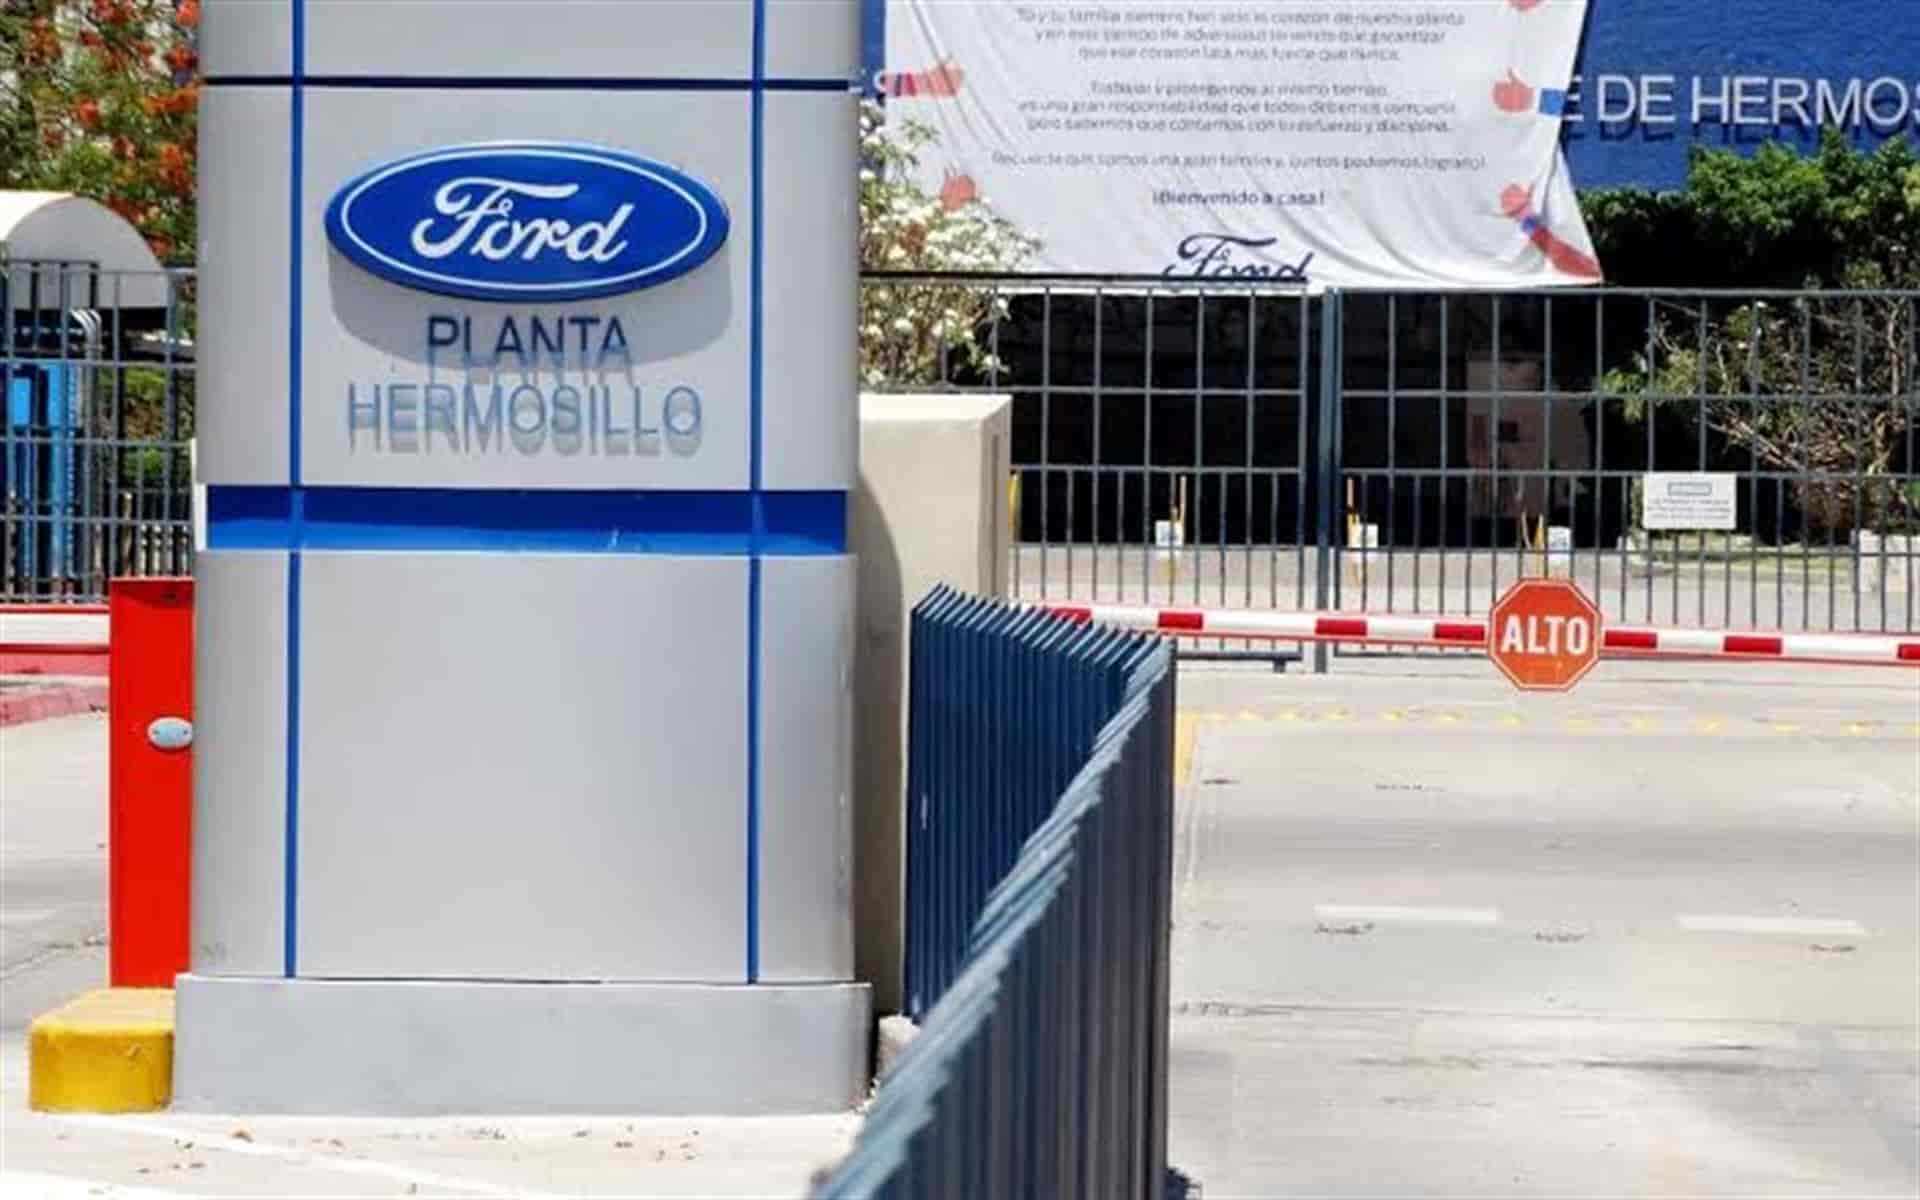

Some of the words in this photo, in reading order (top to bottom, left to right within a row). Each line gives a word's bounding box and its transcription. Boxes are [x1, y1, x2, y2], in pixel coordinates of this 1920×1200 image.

[1069, 9, 1120, 22] familia
[1125, 9, 1183, 25] siempre
[1356, 12, 1412, 24] nuestra
[1416, 10, 1465, 26] planta
[1104, 29, 1158, 43] tiempo
[1183, 29, 1266, 41] adversidad
[1366, 30, 1446, 44] garantizar
[1078, 48, 1106, 60] que
[1272, 48, 1316, 59] fuerte
[1319, 50, 1346, 61] que
[1091, 81, 1151, 95] Trabajar
[1278, 82, 1329, 94] mismo
[1596, 74, 1676, 123] DE
[1692, 75, 1920, 125] HERMO
[1071, 103, 1104, 114] gran
[1108, 101, 1228, 114] responsabilidad
[1231, 104, 1260, 115] que
[1264, 102, 1306, 113] todos
[1310, 102, 1380, 113] debemos
[1028, 120, 1062, 131] pero
[1066, 118, 1134, 129] sabemos
[1137, 121, 1165, 132] que
[1169, 121, 1245, 130] contamos
[1249, 121, 1276, 130] con
[1182, 154, 1216, 168] gran
[1343, 153, 1420, 169] podemos
[1152, 190, 1258, 206] ¡Bienvenido
[1262, 193, 1273, 205] a
[1277, 190, 1326, 206] casa!
[411, 177, 635, 262] Ford
[427, 315, 634, 368] PLANTA
[347, 383, 704, 436] HERMOSILLO
[1501, 614, 1588, 655] ALTO
